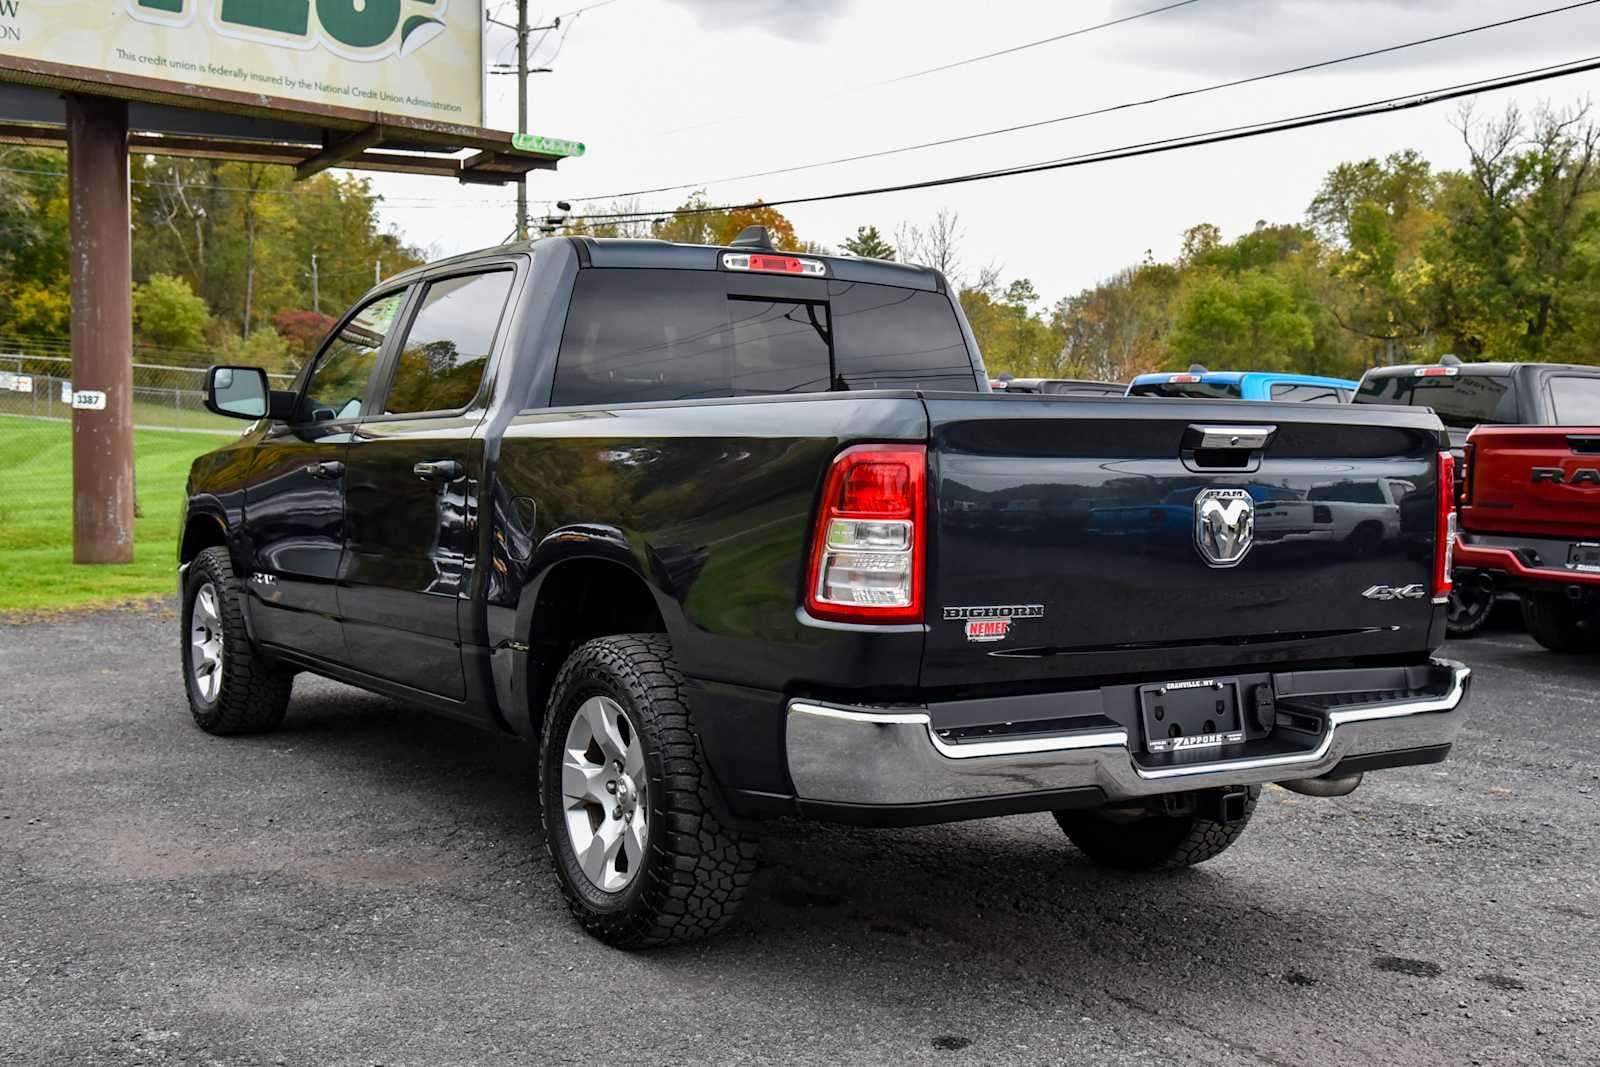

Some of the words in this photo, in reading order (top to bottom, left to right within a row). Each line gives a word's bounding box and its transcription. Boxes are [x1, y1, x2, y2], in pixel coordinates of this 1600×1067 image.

[116, 48, 137, 62] This
[138, 54, 168, 66] credit
[169, 60, 197, 72] union
[199, 64, 206, 73] is
[208, 63, 249, 81] federally
[250, 73, 283, 85] insured
[285, 78, 297, 89] by
[299, 79, 312, 91] the
[314, 82, 350, 96] National
[351, 87, 378, 100] Credit
[379, 91, 404, 104] Union
[405, 96, 462, 113] Administration
[943, 604, 1045, 620] BIGHORN
[1173, 734, 1223, 749] ZAPPONE
